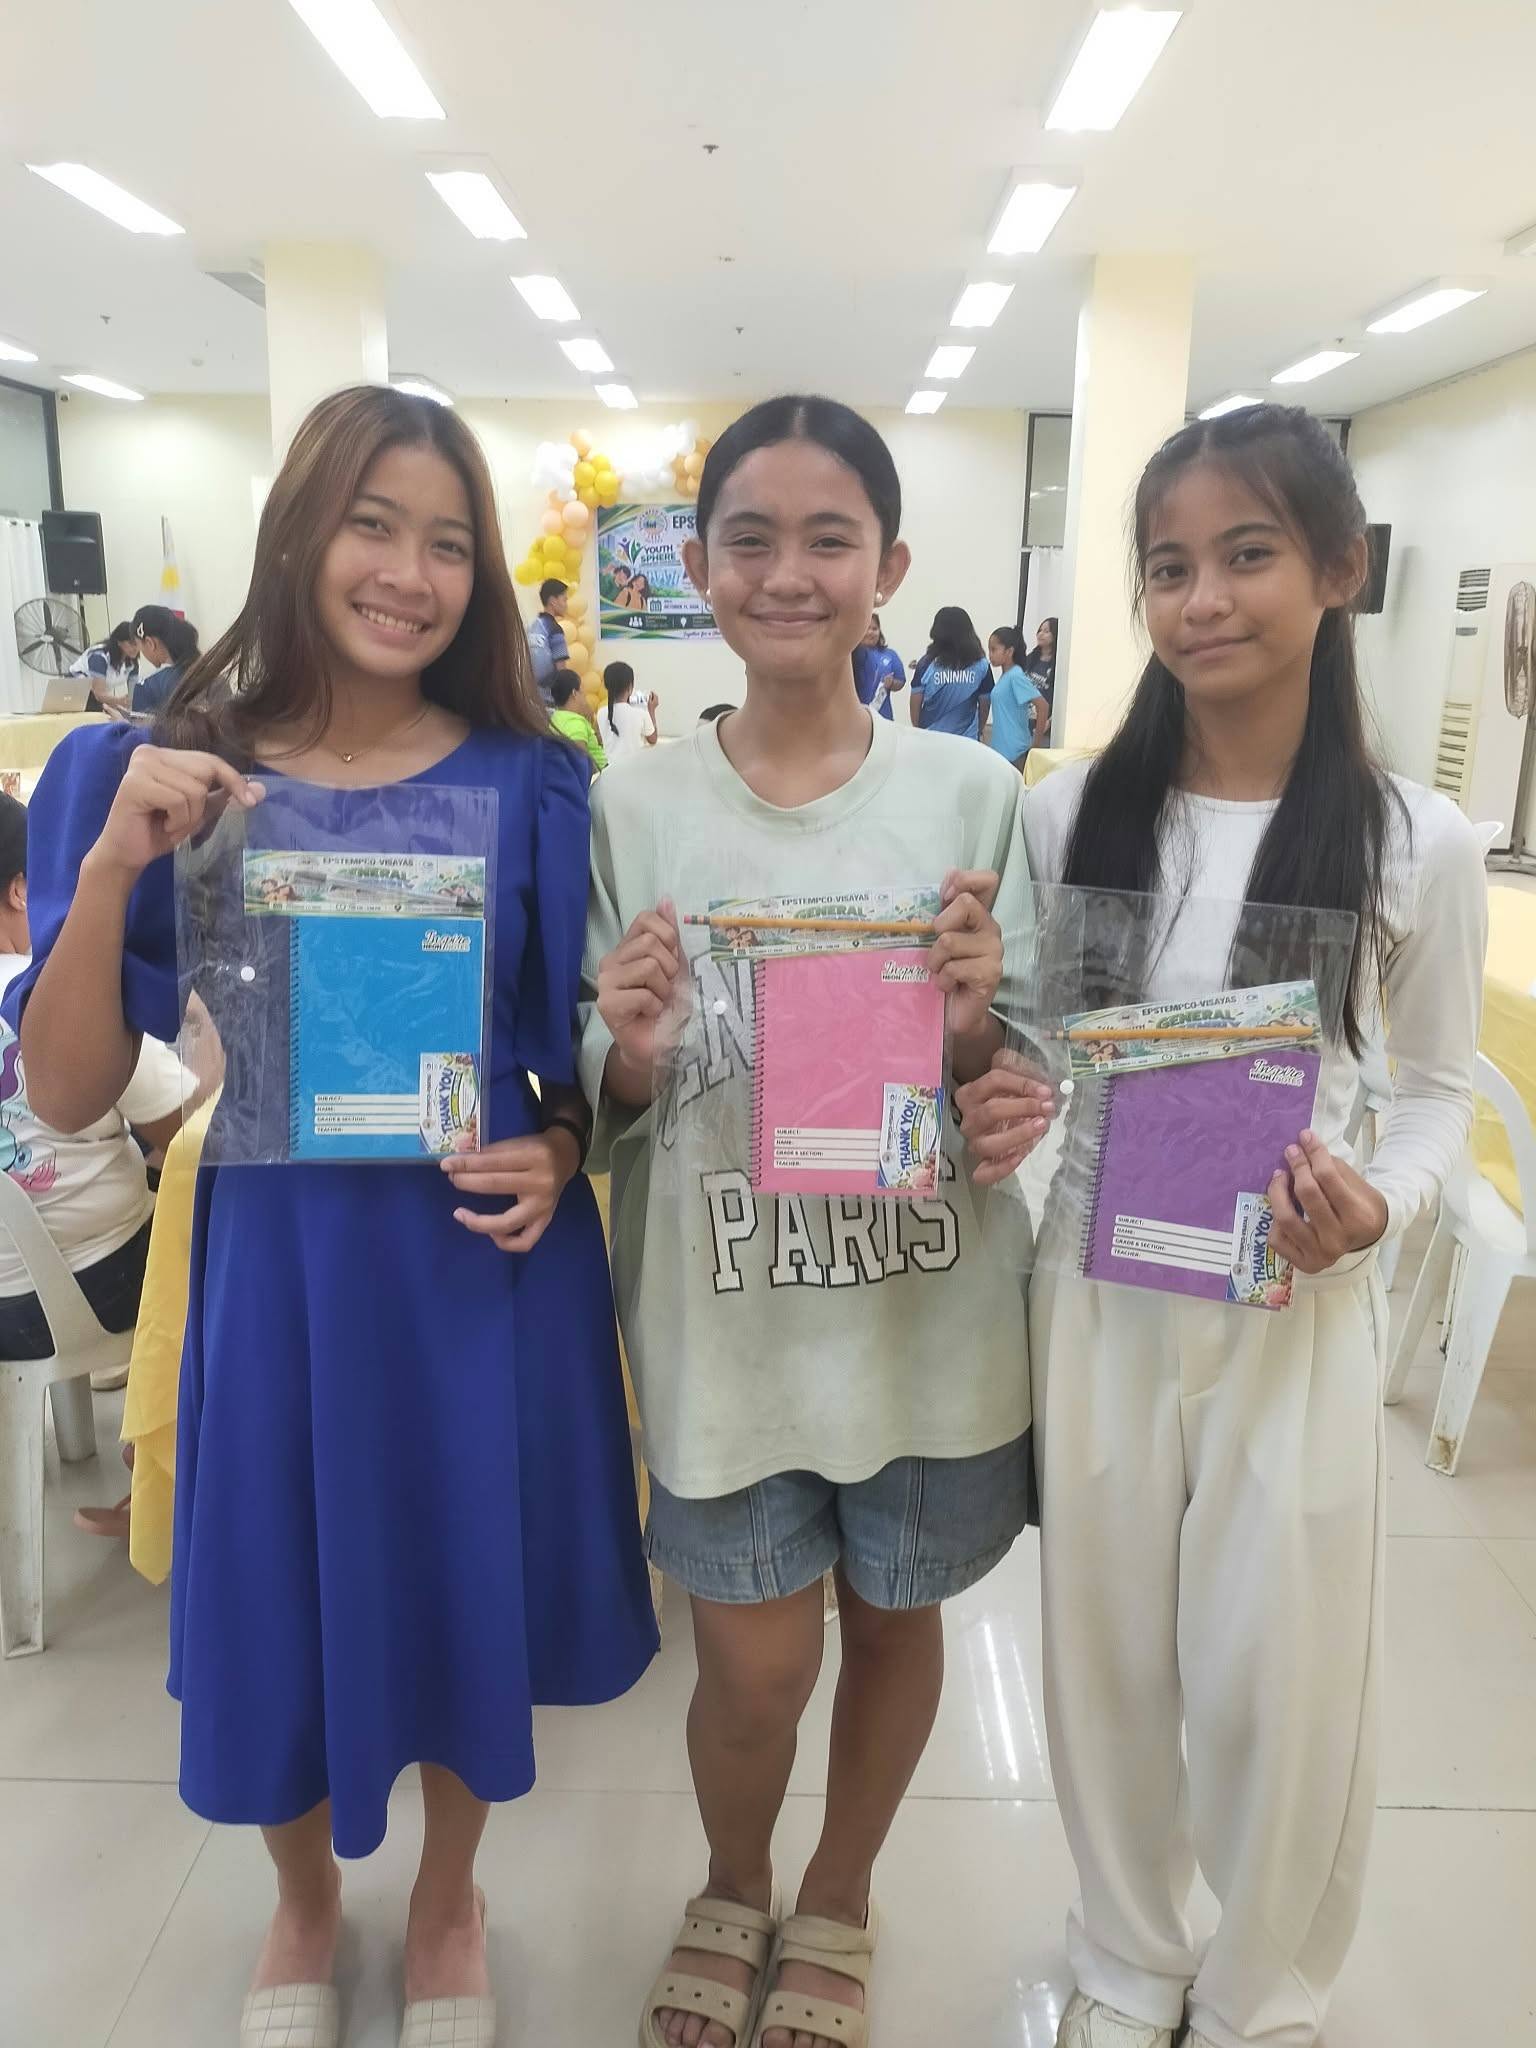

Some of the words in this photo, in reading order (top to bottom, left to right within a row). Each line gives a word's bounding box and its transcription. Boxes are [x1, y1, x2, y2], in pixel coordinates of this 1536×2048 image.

[672, 515, 697, 529] EPS
[641, 553, 676, 563] SPHERE
[644, 545, 673, 555] YOUTH
[933, 670, 975, 685] SININING
[1156, 1009, 1236, 1028] GENERAL
[439, 1067, 454, 1092] YOU
[1255, 1059, 1304, 1081] Inspire
[439, 1095, 453, 1134] THANK
[900, 1099, 916, 1126] YOU
[900, 1128, 912, 1169] THANK
[700, 1158, 960, 1294] PARIS
[1255, 1211, 1273, 1237] YOU
[1253, 1242, 1266, 1284] THANK
